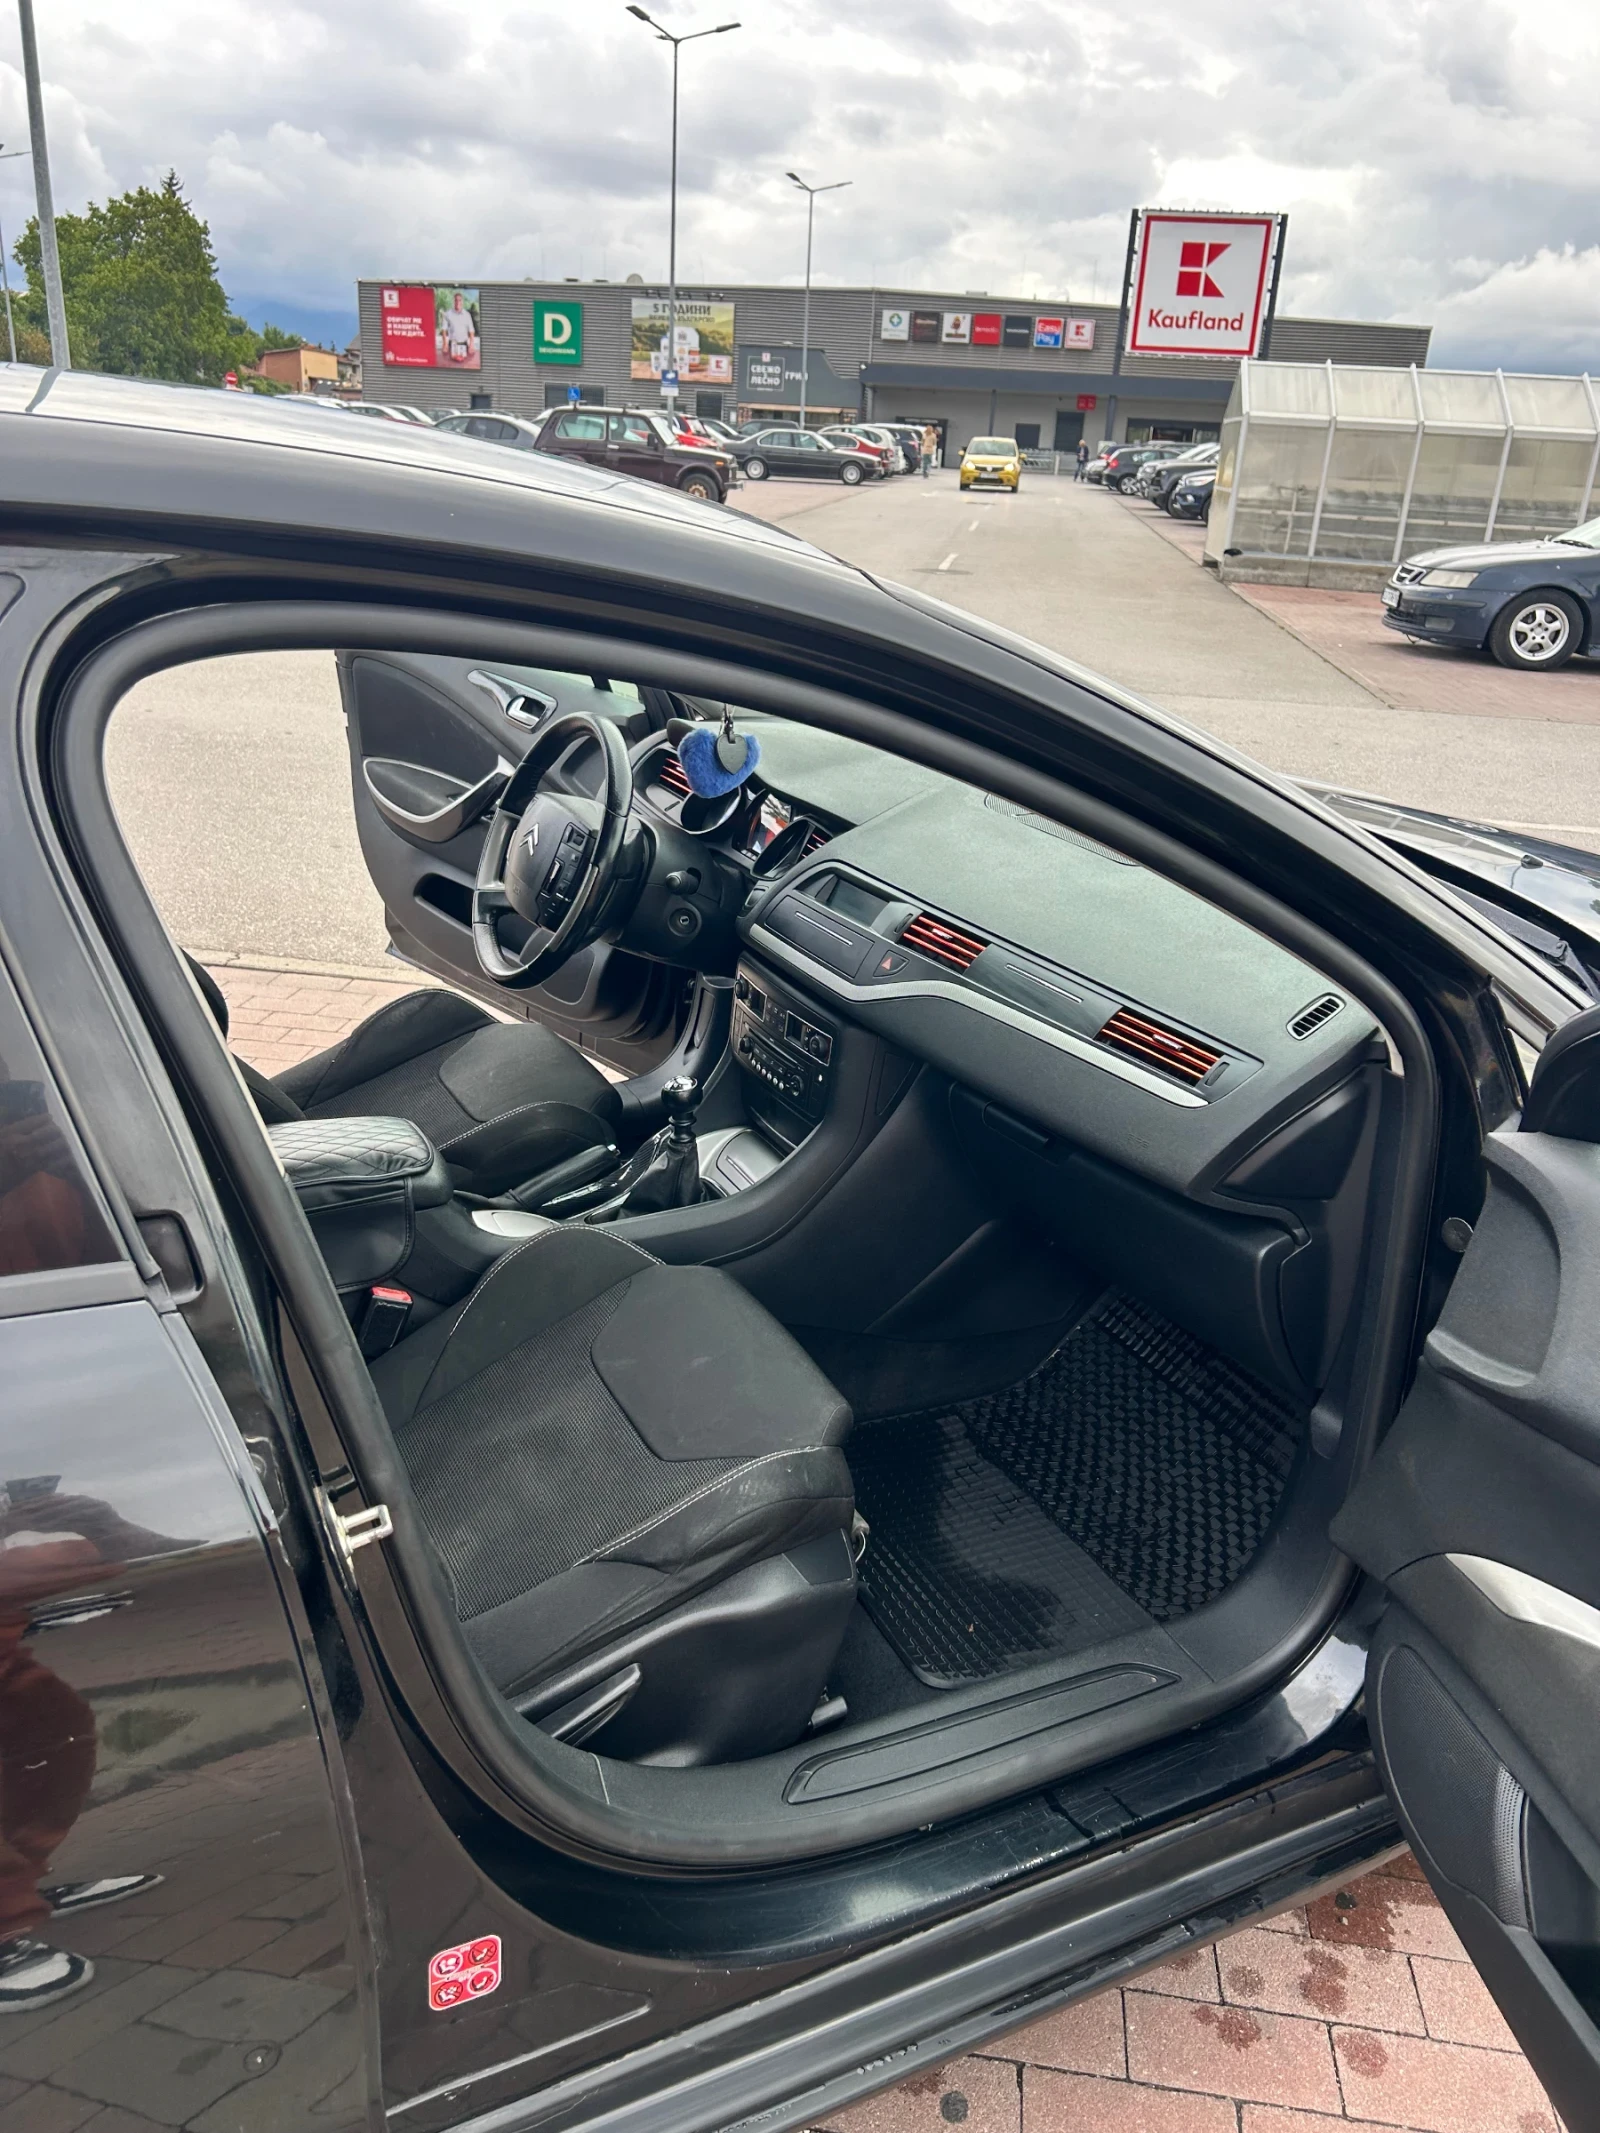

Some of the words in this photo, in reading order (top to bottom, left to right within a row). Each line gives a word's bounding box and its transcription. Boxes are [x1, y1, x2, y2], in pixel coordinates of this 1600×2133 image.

[653, 303, 660, 313] 5
[1147, 309, 1244, 331] Kaufland
[544, 313, 572, 345] D
[1038, 323, 1060, 333] Easy
[1037, 333, 1055, 345] Pay
[751, 365, 781, 374] СВЕЖО
[751, 376, 780, 386] ЛЕСНО
